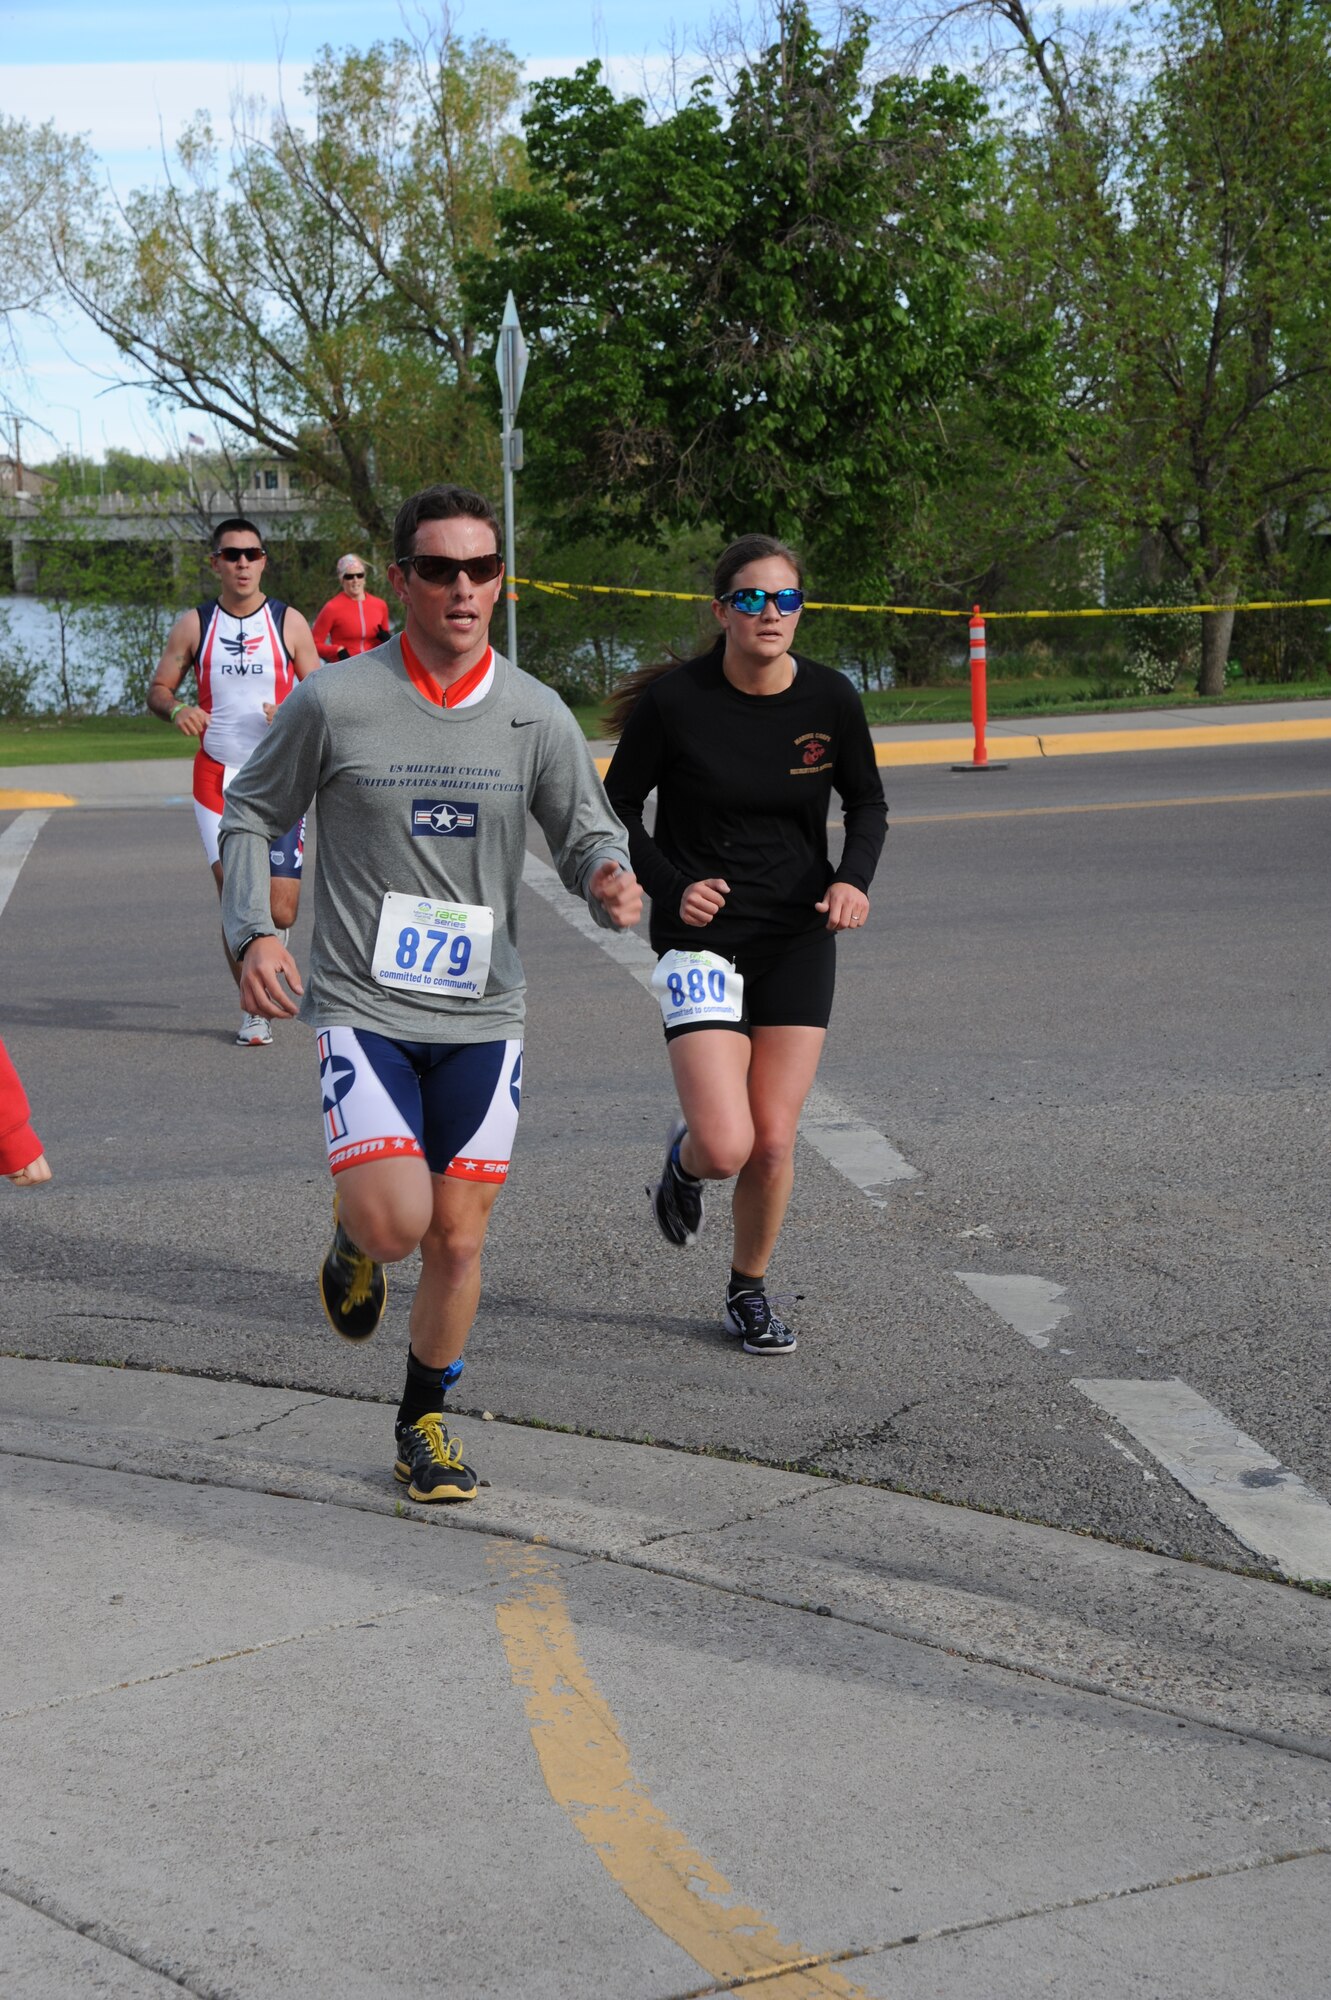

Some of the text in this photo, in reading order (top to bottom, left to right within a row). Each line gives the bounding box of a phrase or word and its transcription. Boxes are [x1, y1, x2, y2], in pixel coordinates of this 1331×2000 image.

[221, 664, 263, 676] RWB
[389, 764, 501, 778] US MILITARY CYCLING
[356, 777, 396, 787] UNITED
[398, 778, 438, 787] STATES
[439, 779, 491, 791] MILITARY
[435, 909, 468, 922] race
[434, 918, 466, 929] series
[395, 927, 472, 976] 879
[379, 969, 478, 992] committed to community
[667, 968, 725, 1007] 880
[694, 1006, 702, 1014] to
[482, 1163, 509, 1174] SR
